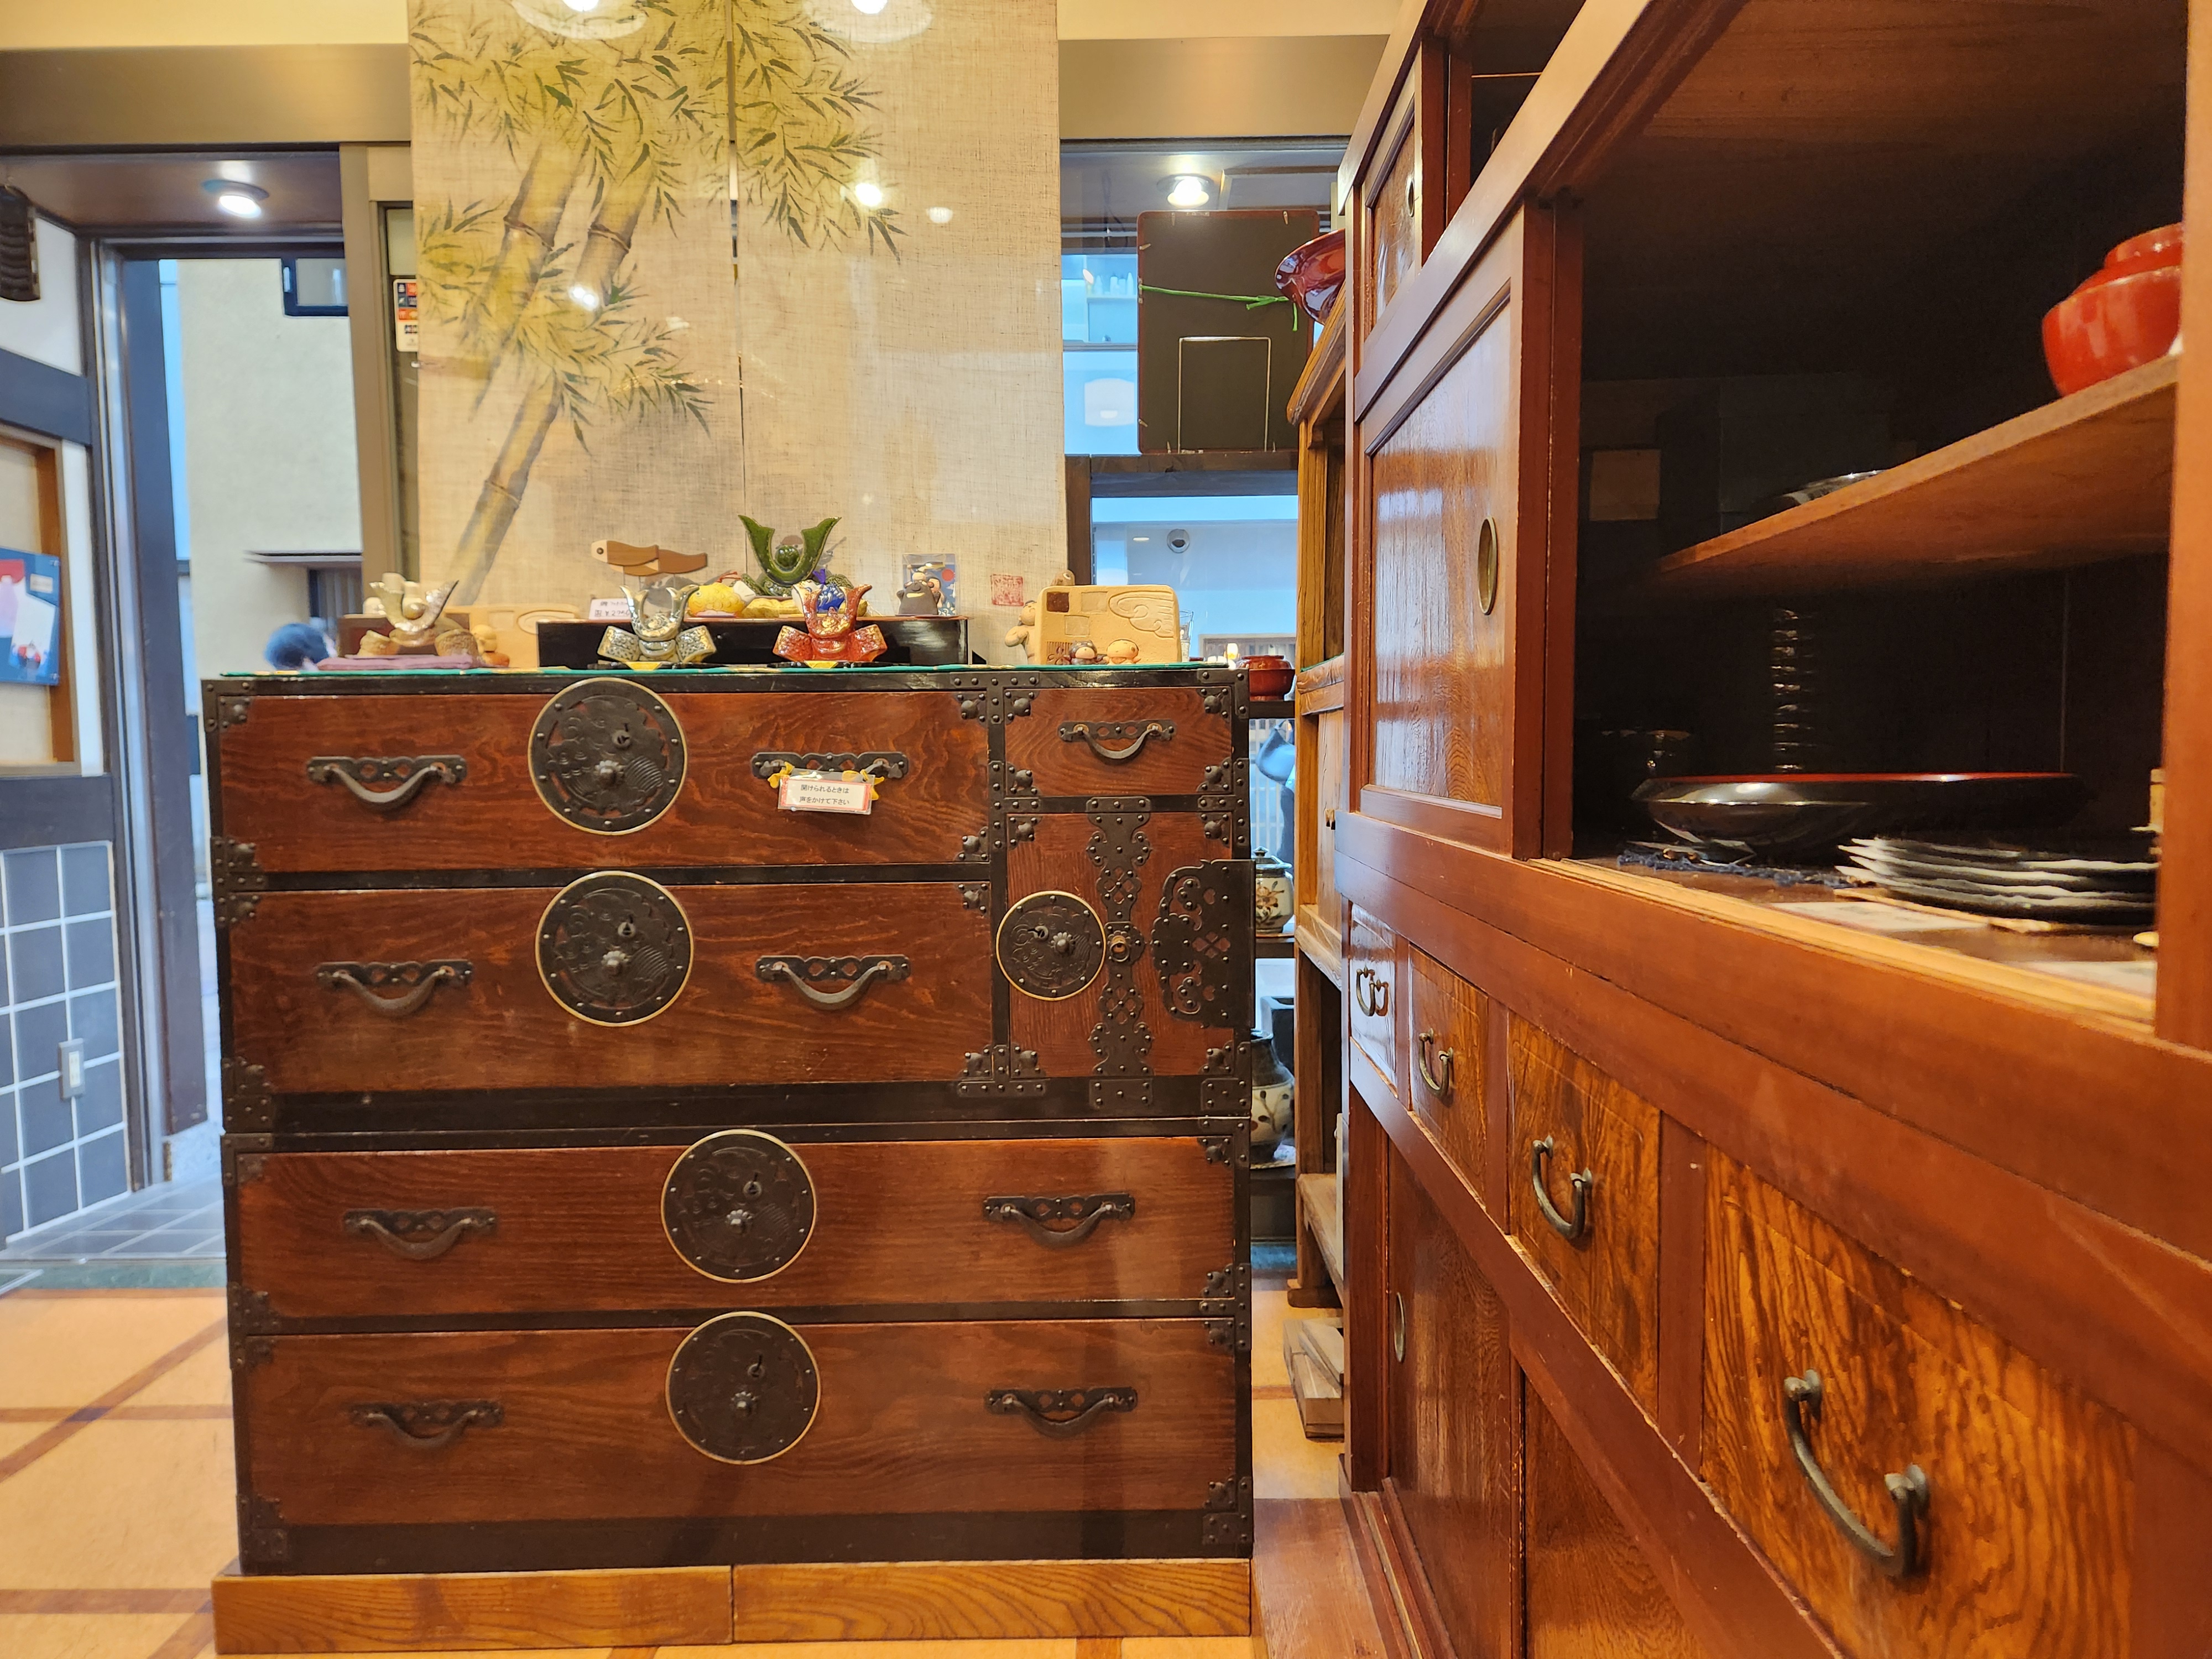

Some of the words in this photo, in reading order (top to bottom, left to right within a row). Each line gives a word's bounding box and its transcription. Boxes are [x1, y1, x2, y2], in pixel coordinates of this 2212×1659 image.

[801, 784, 849, 794] 開けられるときは
[799, 796, 849, 805] 声をかけて下さい
